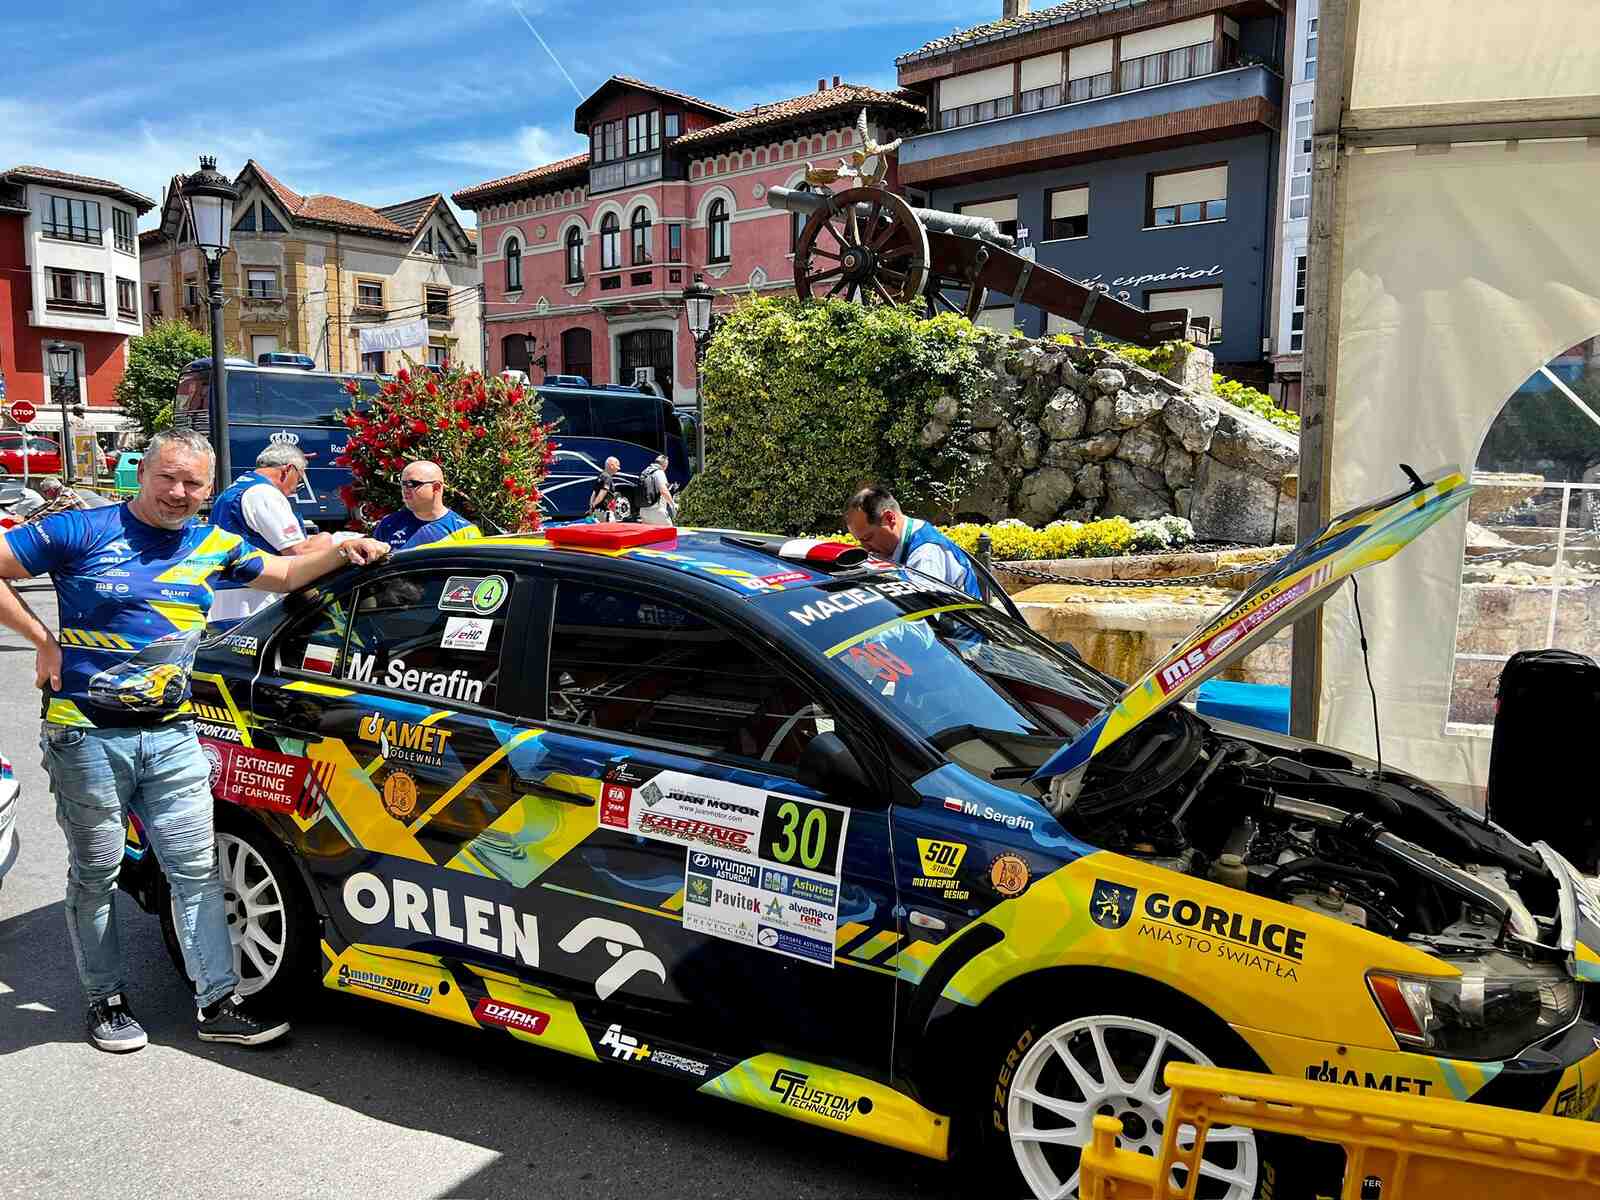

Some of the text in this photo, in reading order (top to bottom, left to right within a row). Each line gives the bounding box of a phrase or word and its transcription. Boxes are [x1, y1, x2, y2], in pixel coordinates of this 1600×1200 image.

[1111, 264, 1224, 287] español
[12, 408, 34, 416] STOP
[330, 443, 349, 454] Rea
[788, 585, 886, 627] MACIEJ
[347, 652, 484, 703] M. Serafin
[235, 754, 296, 778] EXTREME
[231, 784, 244, 795] OF
[234, 770, 286, 792] TESTING
[664, 791, 705, 807] JUAN
[706, 799, 761, 818] MOTOR
[963, 801, 1035, 831] M. Serafin
[771, 801, 828, 870] 30
[924, 841, 961, 868] SOL
[711, 857, 757, 879] HYUNDAI
[715, 869, 751, 885] ASTURDAI
[792, 876, 834, 897] Asturias
[911, 877, 961, 890] MOTORSPORT
[943, 889, 970, 900] DESIGN
[715, 888, 761, 914] Pavitek
[788, 901, 835, 921] alvemaco
[343, 871, 540, 969] ORLEN
[800, 913, 823, 927] rent
[1144, 892, 1307, 961] GORLICE
[1137, 923, 1299, 983] MIASTO ŚWIATŁA
[484, 1002, 541, 1025] DZIAK
[788, 1097, 852, 1122] TECHNOLOGY
[790, 1084, 857, 1114] CUSTOM
